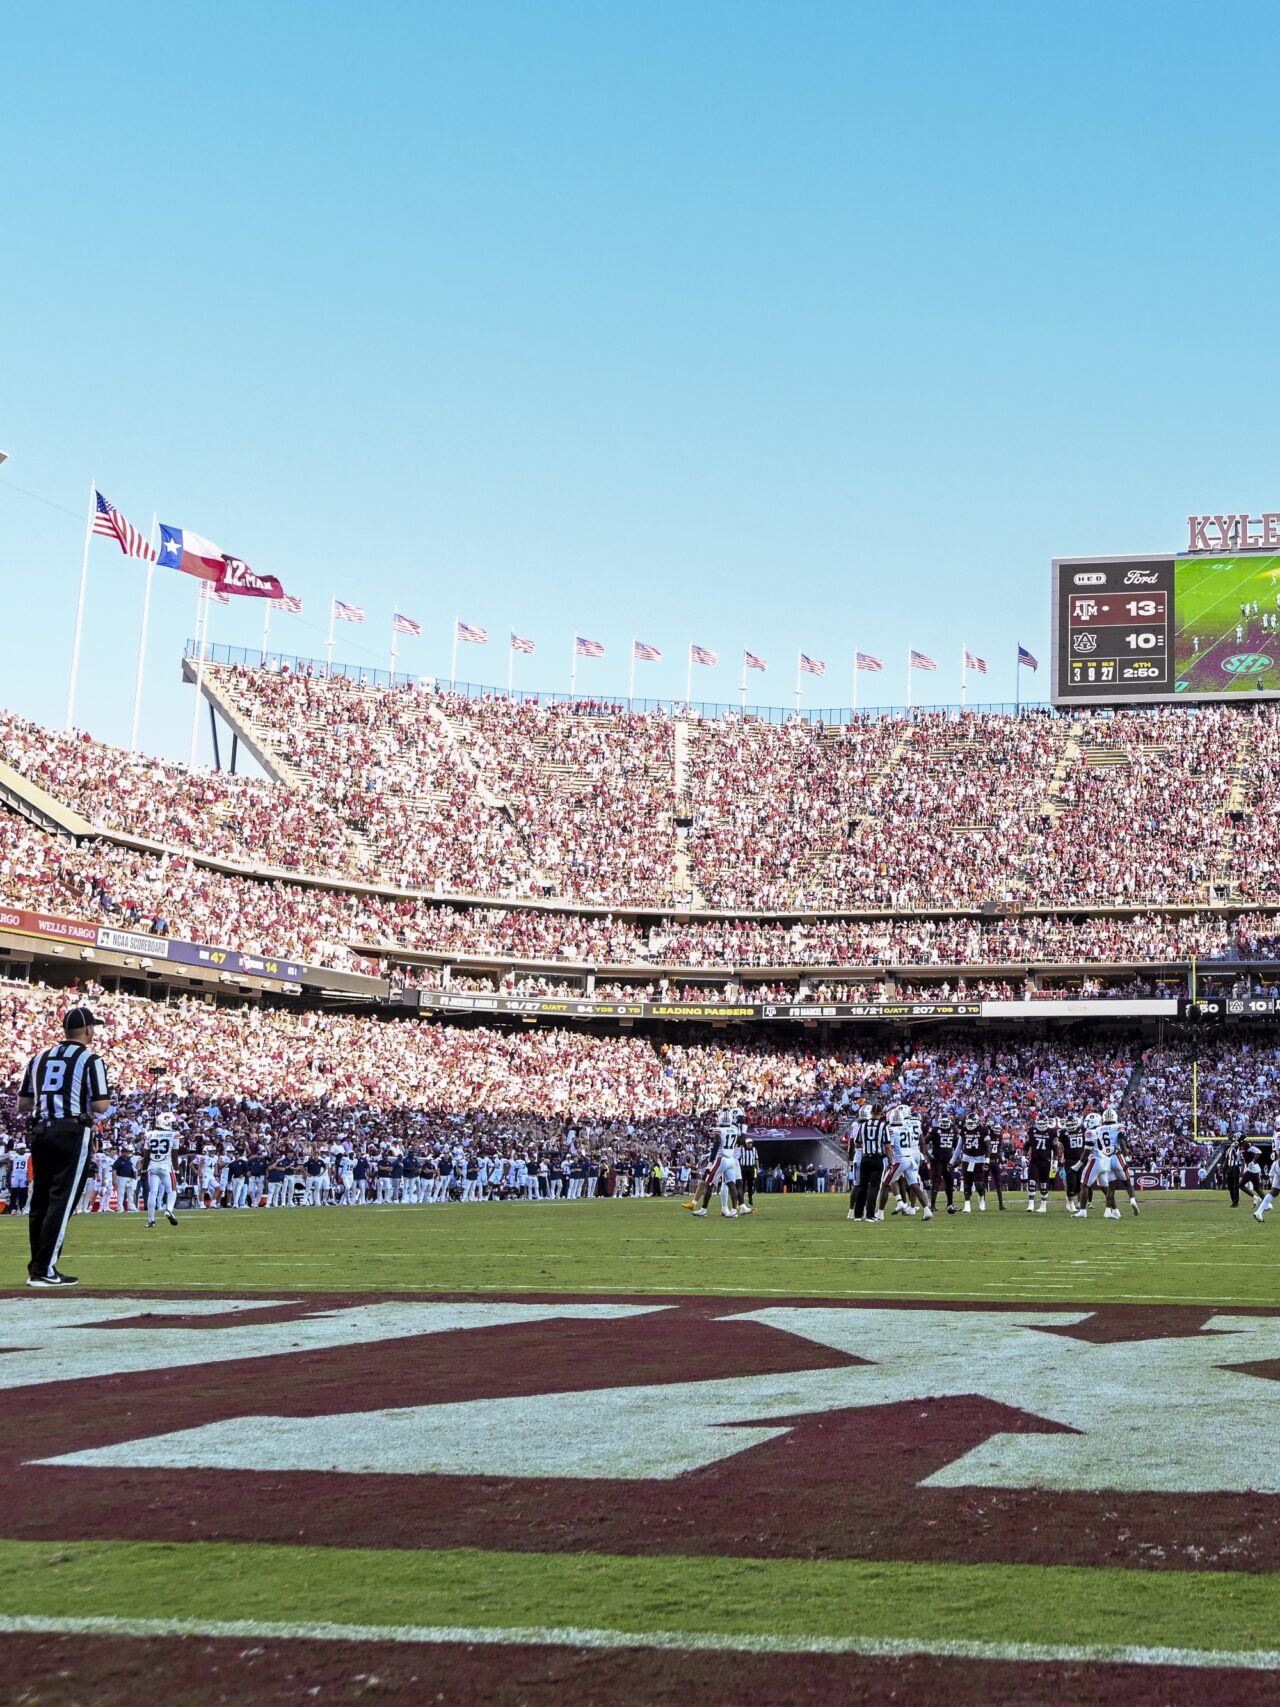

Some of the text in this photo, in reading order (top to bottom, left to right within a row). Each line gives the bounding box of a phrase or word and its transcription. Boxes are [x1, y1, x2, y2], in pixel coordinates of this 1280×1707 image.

[224, 560, 246, 587] 12
[1124, 570, 1159, 585] Ford
[1125, 601, 1156, 616] 13
[1126, 633, 1156, 649] 10
[1224, 655, 1271, 673] SEC
[1074, 668, 1081, 681] 3
[1101, 667, 1113, 680] 27
[1123, 668, 1159, 678] 2:50
[0, 913, 20, 926] RGO
[38, 920, 96, 939] WELLS FARGO
[112, 933, 166, 954] NCAA SCOREBOARD
[210, 952, 226, 964] 47
[265, 962, 278, 974] 14
[652, 1007, 754, 1016] LEADING PASSERS
[912, 1006, 935, 1014] 207
[1248, 1001, 1267, 1011] 10
[42, 1060, 66, 1092] B
[867, 1126, 878, 1140] U
[900, 1131, 911, 1148] 21
[1102, 1132, 1111, 1147] 6
[150, 1139, 170, 1154] 23
[723, 1133, 737, 1149] 17
[940, 1136, 953, 1148] 55
[965, 1138, 979, 1149] 54
[1036, 1139, 1046, 1150] 71
[1070, 1137, 1083, 1148] 60
[15, 1161, 26, 1170] 19
